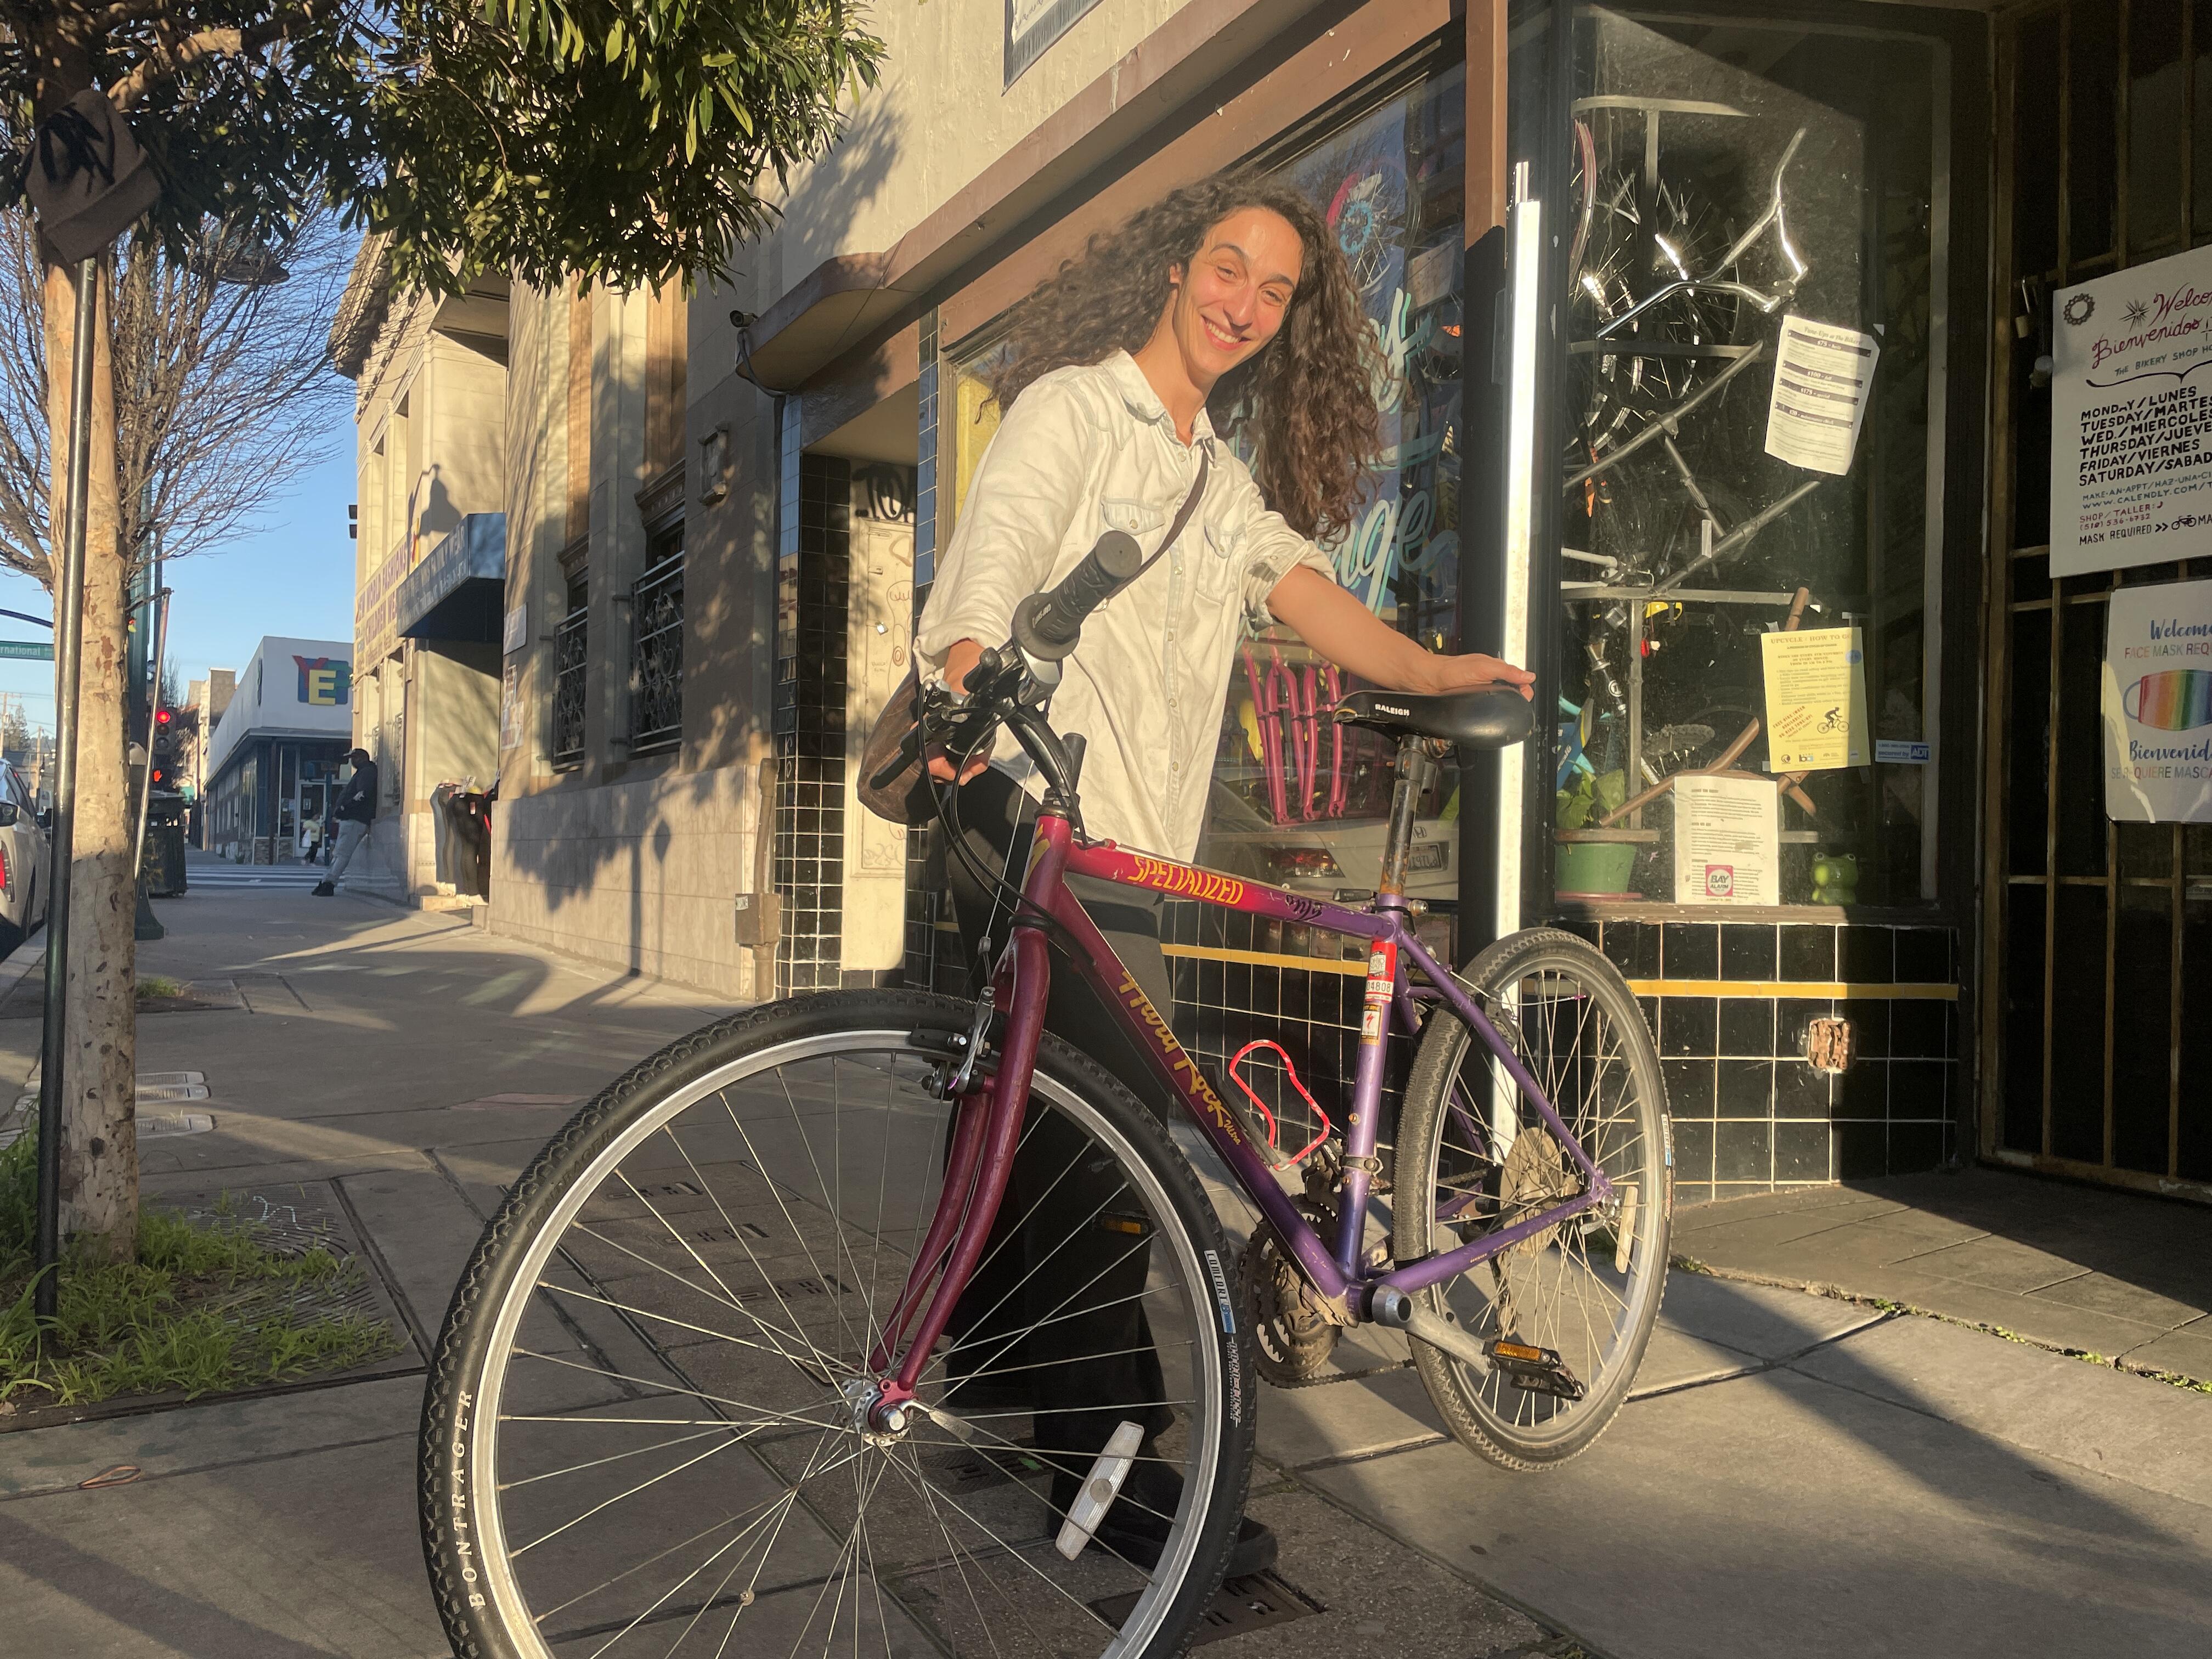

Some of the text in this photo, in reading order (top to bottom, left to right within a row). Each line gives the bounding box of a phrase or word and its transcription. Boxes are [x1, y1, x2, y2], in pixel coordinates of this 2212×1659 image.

[2115, 365, 2129, 376] THE
[2135, 354, 2167, 370] BIKERY
[2172, 347, 2198, 361] SHOP
[2079, 533, 2105, 546] MASK
[2110, 524, 2152, 540] REQUIRED
[1770, 636, 1803, 644] UPCYCLE
[2125, 646, 2151, 659] FACE
[2153, 644, 2184, 657] MASK
[1375, 703, 1410, 716] RALEIGH
[2112, 767, 2121, 779] SE
[1127, 855, 1244, 905] SPECIALIZED
[1711, 874, 1730, 883] BAY
[1206, 1253, 1228, 1304] COMFORT
[452, 1390, 486, 1609] BONTRAGER
